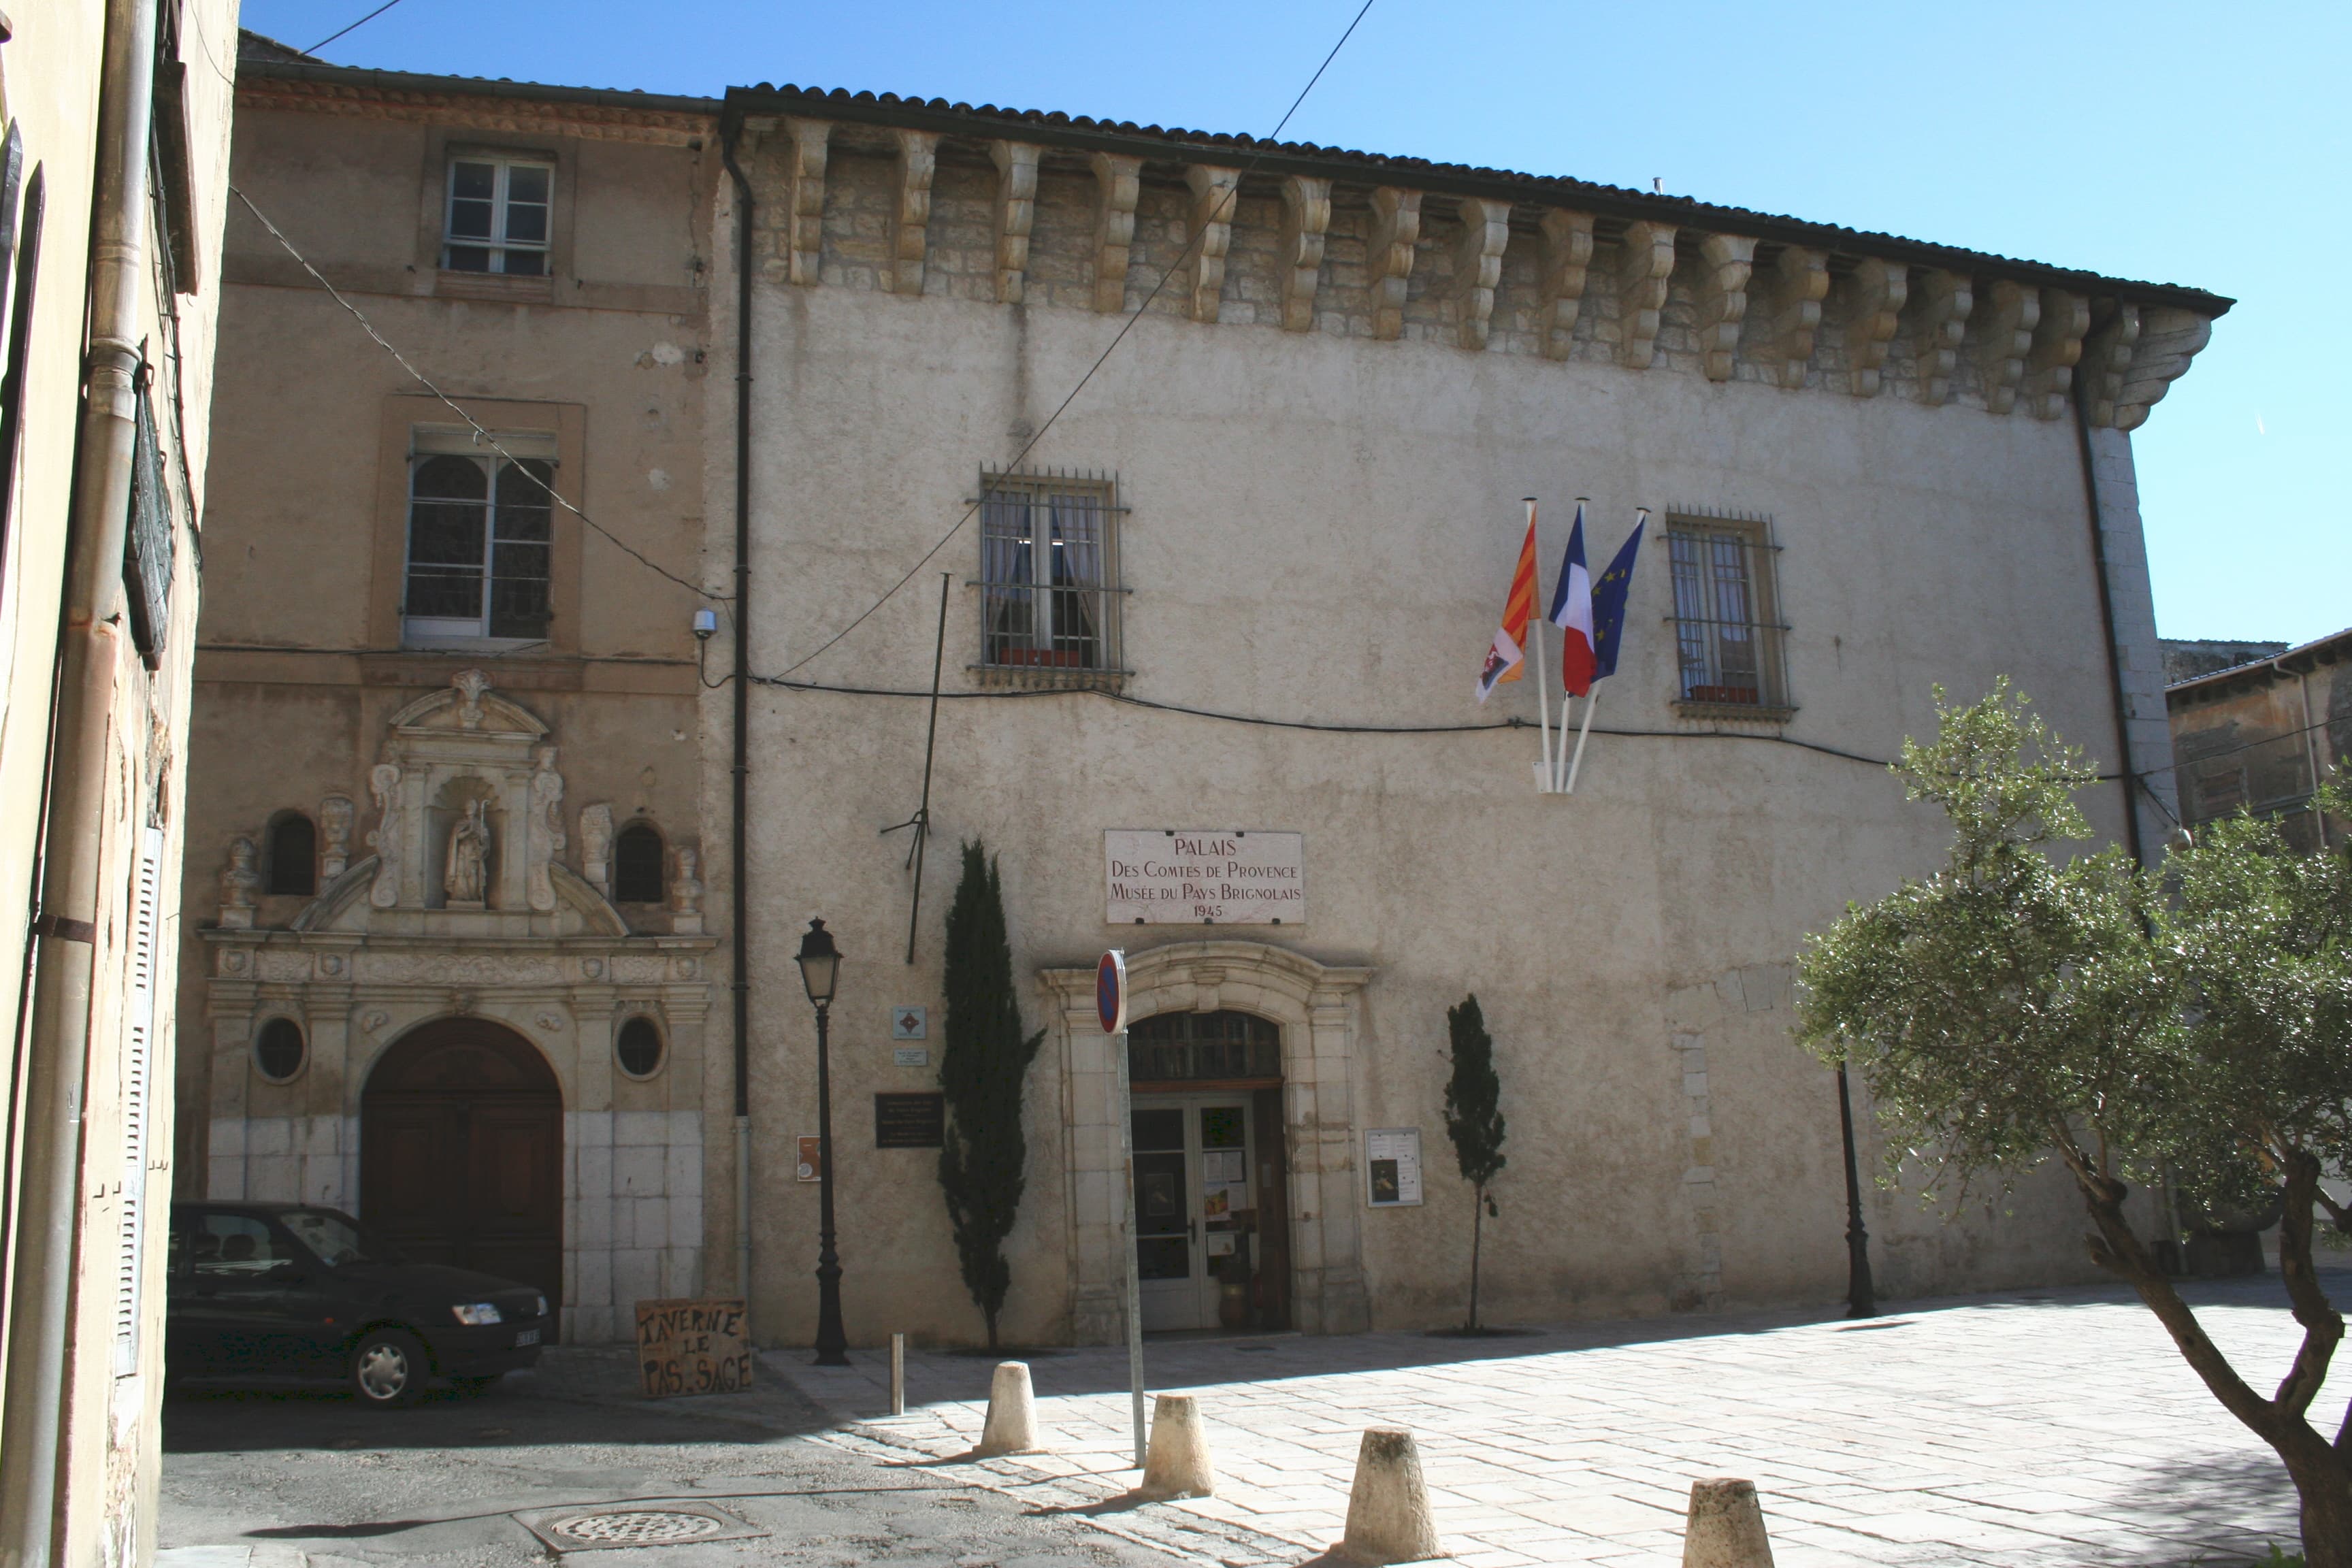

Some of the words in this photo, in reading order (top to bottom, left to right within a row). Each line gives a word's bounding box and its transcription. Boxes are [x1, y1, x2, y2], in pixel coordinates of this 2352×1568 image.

[1175, 838, 1237, 856] PALAIS
[1111, 860, 1139, 878] DES
[1144, 861, 1201, 878] COMTES
[1206, 866, 1222, 878] DE
[1228, 862, 1297, 879] PROVENCE
[1111, 883, 1156, 900] MUSÉE
[1161, 887, 1178, 900] DU
[1182, 883, 1216, 900] PAYS
[1221, 883, 1302, 900] BRIGNOLAIS
[1194, 905, 1223, 917] 1945
[639, 1308, 745, 1344] TAVERNE
[683, 1335, 710, 1354] LE
